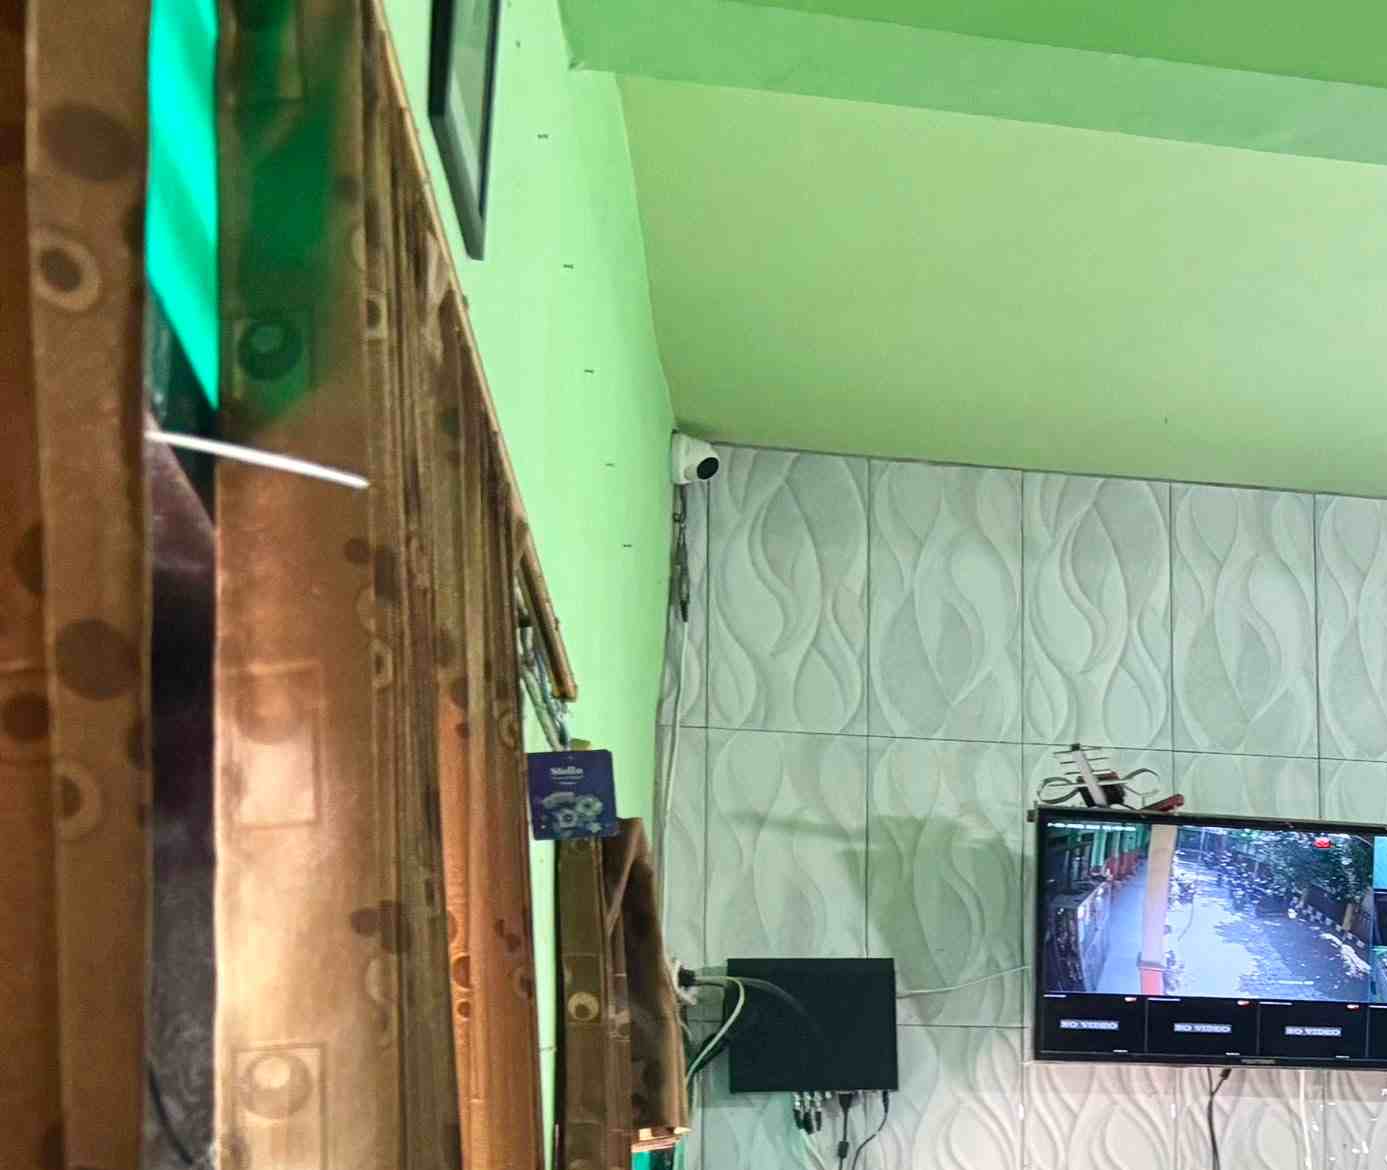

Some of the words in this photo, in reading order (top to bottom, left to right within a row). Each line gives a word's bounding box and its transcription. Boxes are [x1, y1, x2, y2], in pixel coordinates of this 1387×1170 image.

[1082, 1020, 1119, 1030] VIDEO
[1194, 1024, 1231, 1033] VIDEO
[1305, 1027, 1341, 1036] VIDEO
